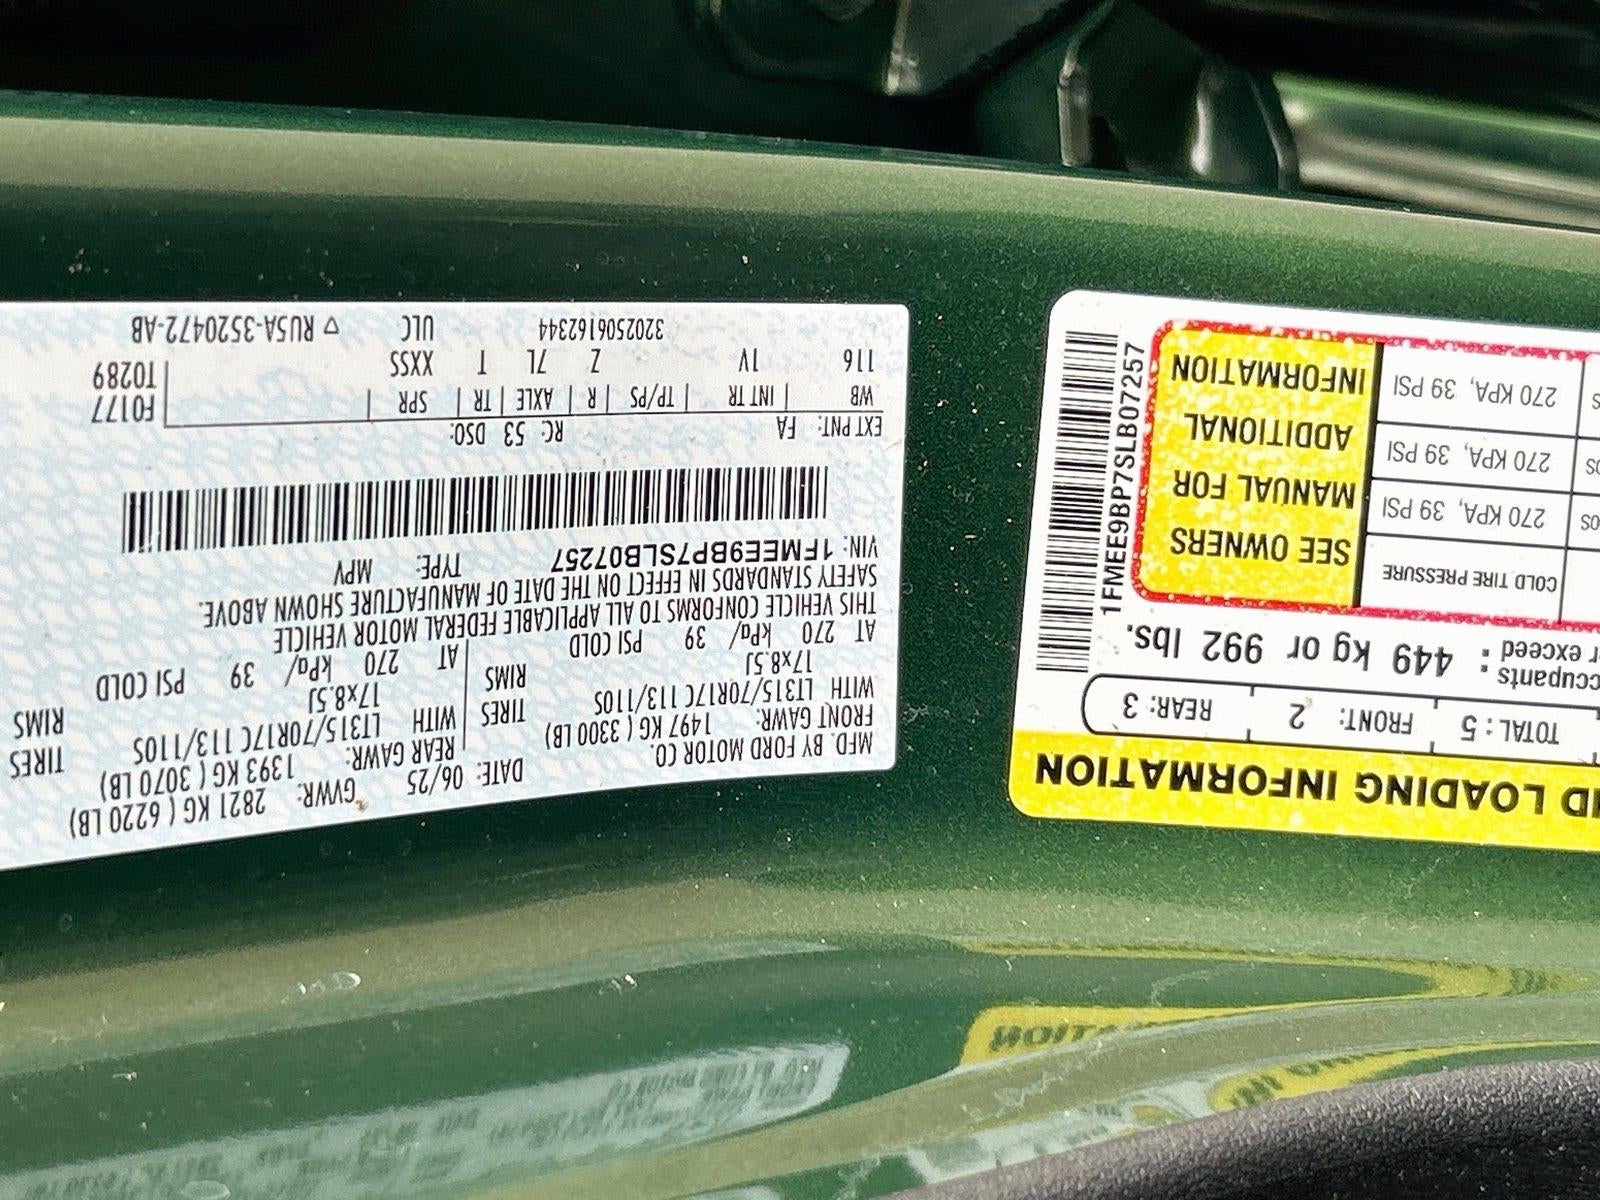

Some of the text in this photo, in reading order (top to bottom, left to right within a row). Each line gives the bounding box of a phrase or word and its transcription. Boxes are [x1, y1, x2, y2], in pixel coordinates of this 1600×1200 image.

[401, 315, 434, 342] ULC
[538, 318, 664, 341] 3202506162344
[390, 350, 434, 377] XXSS
[478, 350, 486, 374] T
[527, 349, 547, 374] 7L
[590, 348, 600, 374] Z
[738, 348, 758, 372] 1V
[843, 348, 874, 372] 116
[1172, 354, 1366, 395] INFORMATION
[398, 390, 428, 414] SPR
[474, 389, 492, 412] TR
[516, 388, 553, 412] AXLE
[588, 388, 596, 408] R
[630, 383, 674, 410] TP/PS
[728, 385, 774, 406] INT TR
[850, 385, 873, 406] WB
[1394, 375, 1557, 408] 270 KPA, 39 PSI
[450, 420, 563, 446] RC: 53 DSO:
[776, 415, 882, 440] EXT PNT: FA
[1184, 412, 1353, 451] ADDITIONAL
[1387, 440, 1550, 473] 270 KPA, 39 PSI
[1100, 342, 1145, 615] 1FMEE9BP7SLB07257
[1172, 470, 1356, 508] MANUAL FOR
[1382, 496, 1545, 528] 270 KPA, 39 PSI
[550, 534, 878, 572] VIN: 1FMEE9BP7SLB07257
[1170, 527, 1351, 566] SEE OWNERS
[334, 553, 461, 586] TYPE: MPV
[1382, 564, 1557, 592] COLD TIRE PRESSURE
[198, 564, 877, 628] SAFETY STANDARDS IN EFFECT ON THE DATE OF MANUFACTURE SHOWN ABOVE.
[274, 592, 876, 654] THIS VEHICLE CONFORMS TO ALL APPLICABLE FEDERAL MOTOR VEHICLE
[569, 619, 876, 658] AT 270 kPa/ 39 PSI COLD
[1126, 624, 1181, 658] lbs.
[1202, 630, 1263, 664] 992
[1287, 636, 1320, 661] or
[1333, 631, 1370, 672] kg
[1501, 640, 1582, 662] exceed
[96, 644, 458, 700] AT 270 kPa/ 39 PSI COLD
[745, 650, 812, 675] 17x8.5J
[1392, 643, 1453, 678] 449
[485, 664, 526, 691] RIMS
[831, 676, 874, 700] WITH
[308, 682, 380, 714] 17x8.5J
[481, 698, 525, 726] TIRES
[1122, 692, 1212, 722] REAR: 3
[14, 706, 64, 739] RIMS
[412, 706, 456, 734] WITH
[640, 715, 662, 740] KG
[670, 712, 710, 738] 1497
[756, 707, 811, 732] GAWR:
[818, 703, 873, 729] FRONT
[1288, 703, 1413, 735] FRONT: 2
[545, 722, 572, 749] LB)
[650, 731, 873, 768] MFD. BY FORD MOTOR CO.
[10, 746, 64, 779] TIRES
[346, 742, 404, 770] GAWR:
[412, 736, 454, 764] REAR
[213, 760, 238, 788] KG
[247, 754, 294, 784] 1393
[408, 758, 523, 795] DATE: 06/25
[1035, 753, 1337, 802] INFORMATION
[100, 771, 131, 802] LB)
[298, 778, 356, 808] GVWR:
[1354, 772, 1545, 815] LOADING
[184, 796, 210, 824] KG
[220, 788, 266, 818] 2821
[70, 808, 100, 839] LB)
